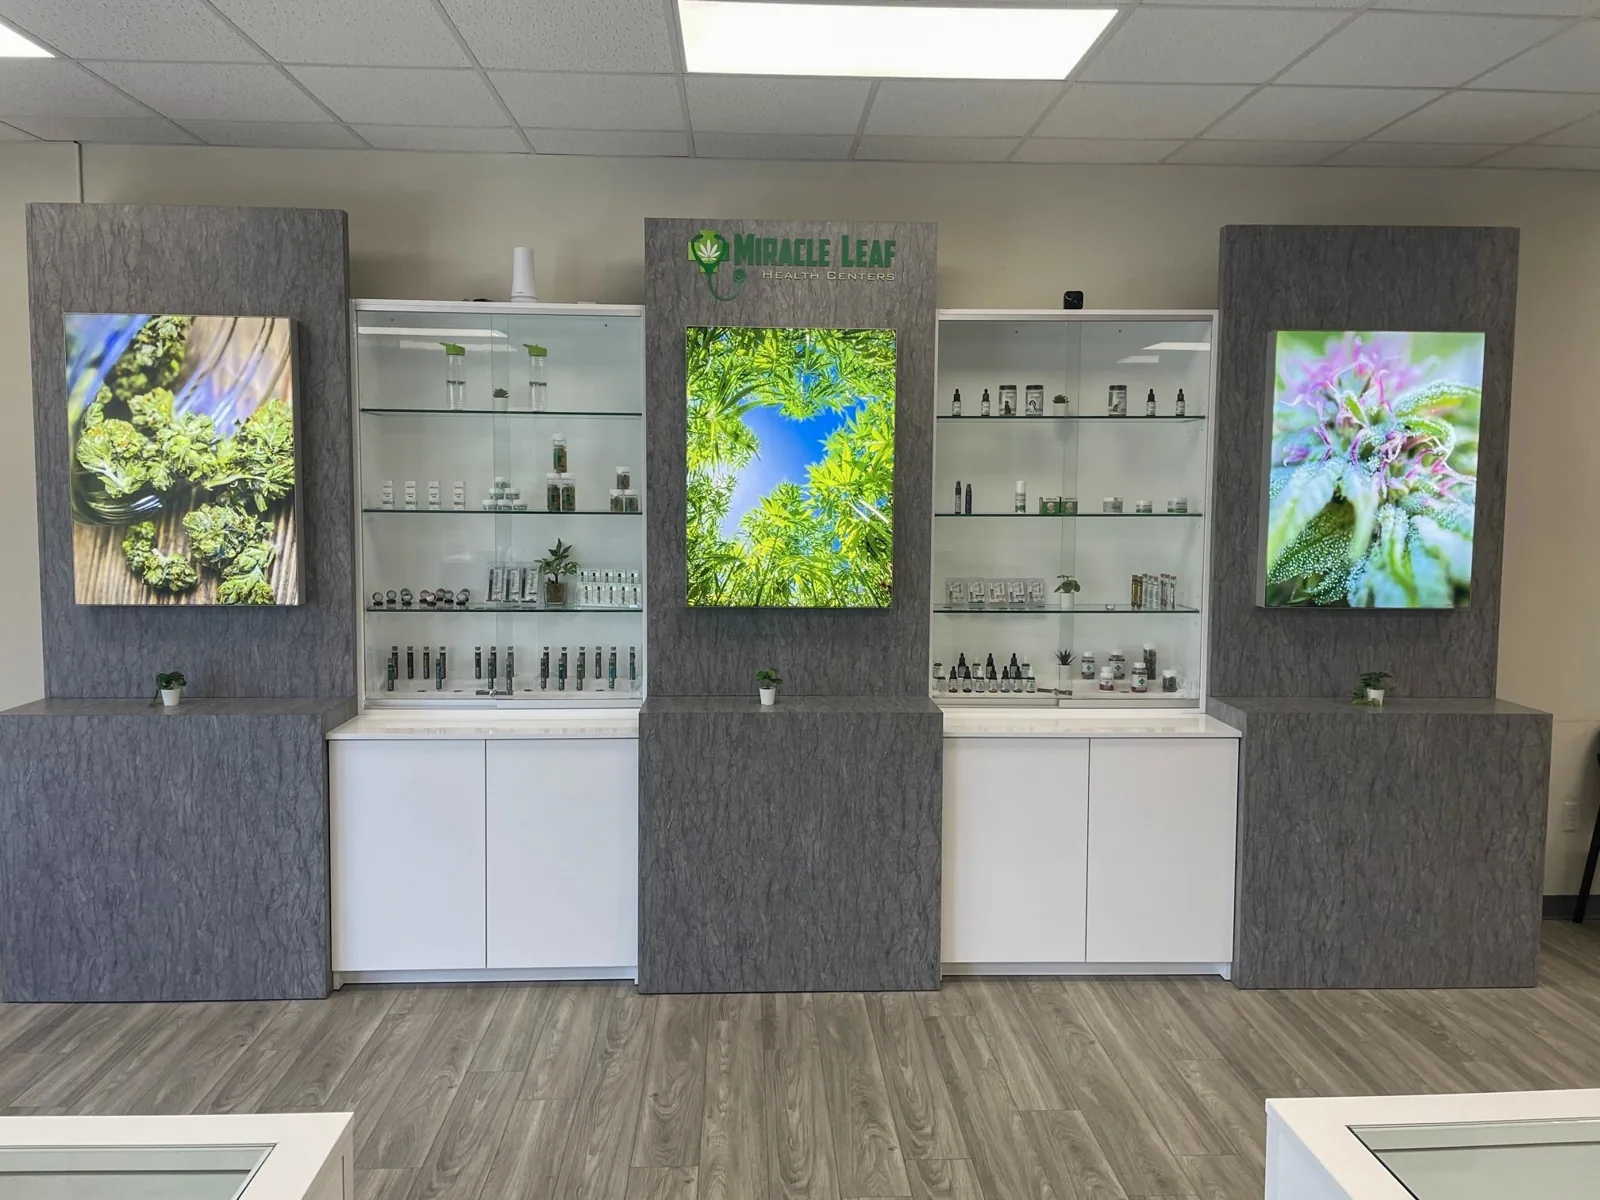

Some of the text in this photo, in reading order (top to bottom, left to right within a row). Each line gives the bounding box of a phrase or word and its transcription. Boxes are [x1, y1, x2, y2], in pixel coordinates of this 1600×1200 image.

[734, 233, 896, 268] MIRACLE LEAF
[762, 270, 895, 281] HEALTH CENTERS
